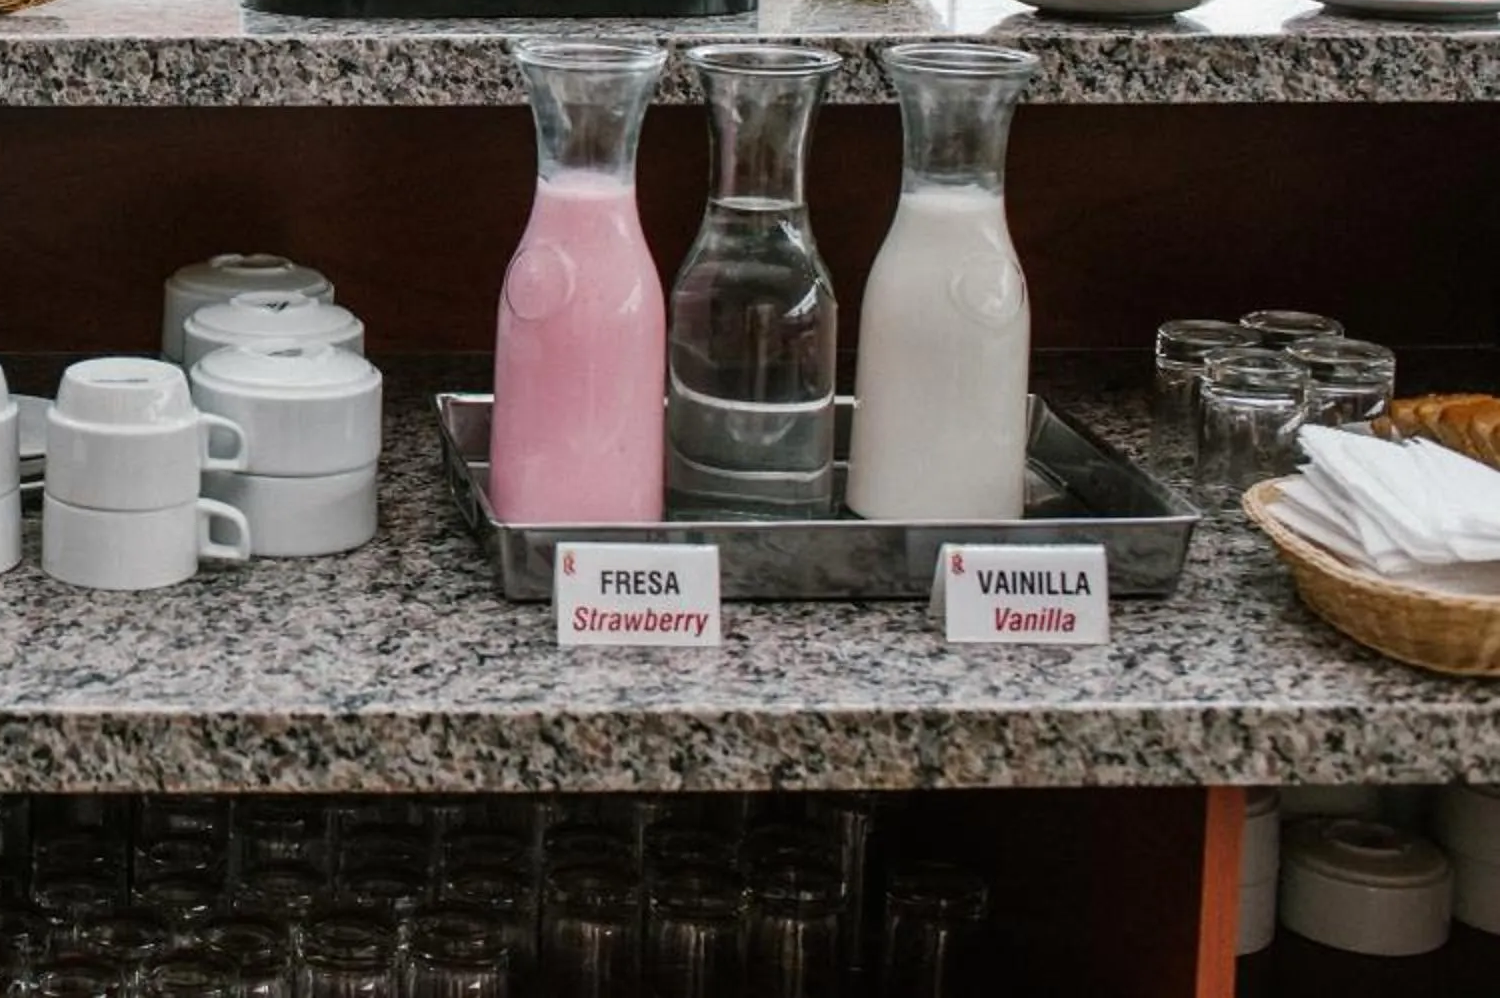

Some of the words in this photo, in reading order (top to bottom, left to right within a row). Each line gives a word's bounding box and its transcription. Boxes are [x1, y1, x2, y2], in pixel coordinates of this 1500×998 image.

[601, 570, 680, 594] FRESA
[978, 570, 1091, 595] VAINILLA
[573, 606, 709, 637] Strawberry
[995, 607, 1076, 632] Vanilla
